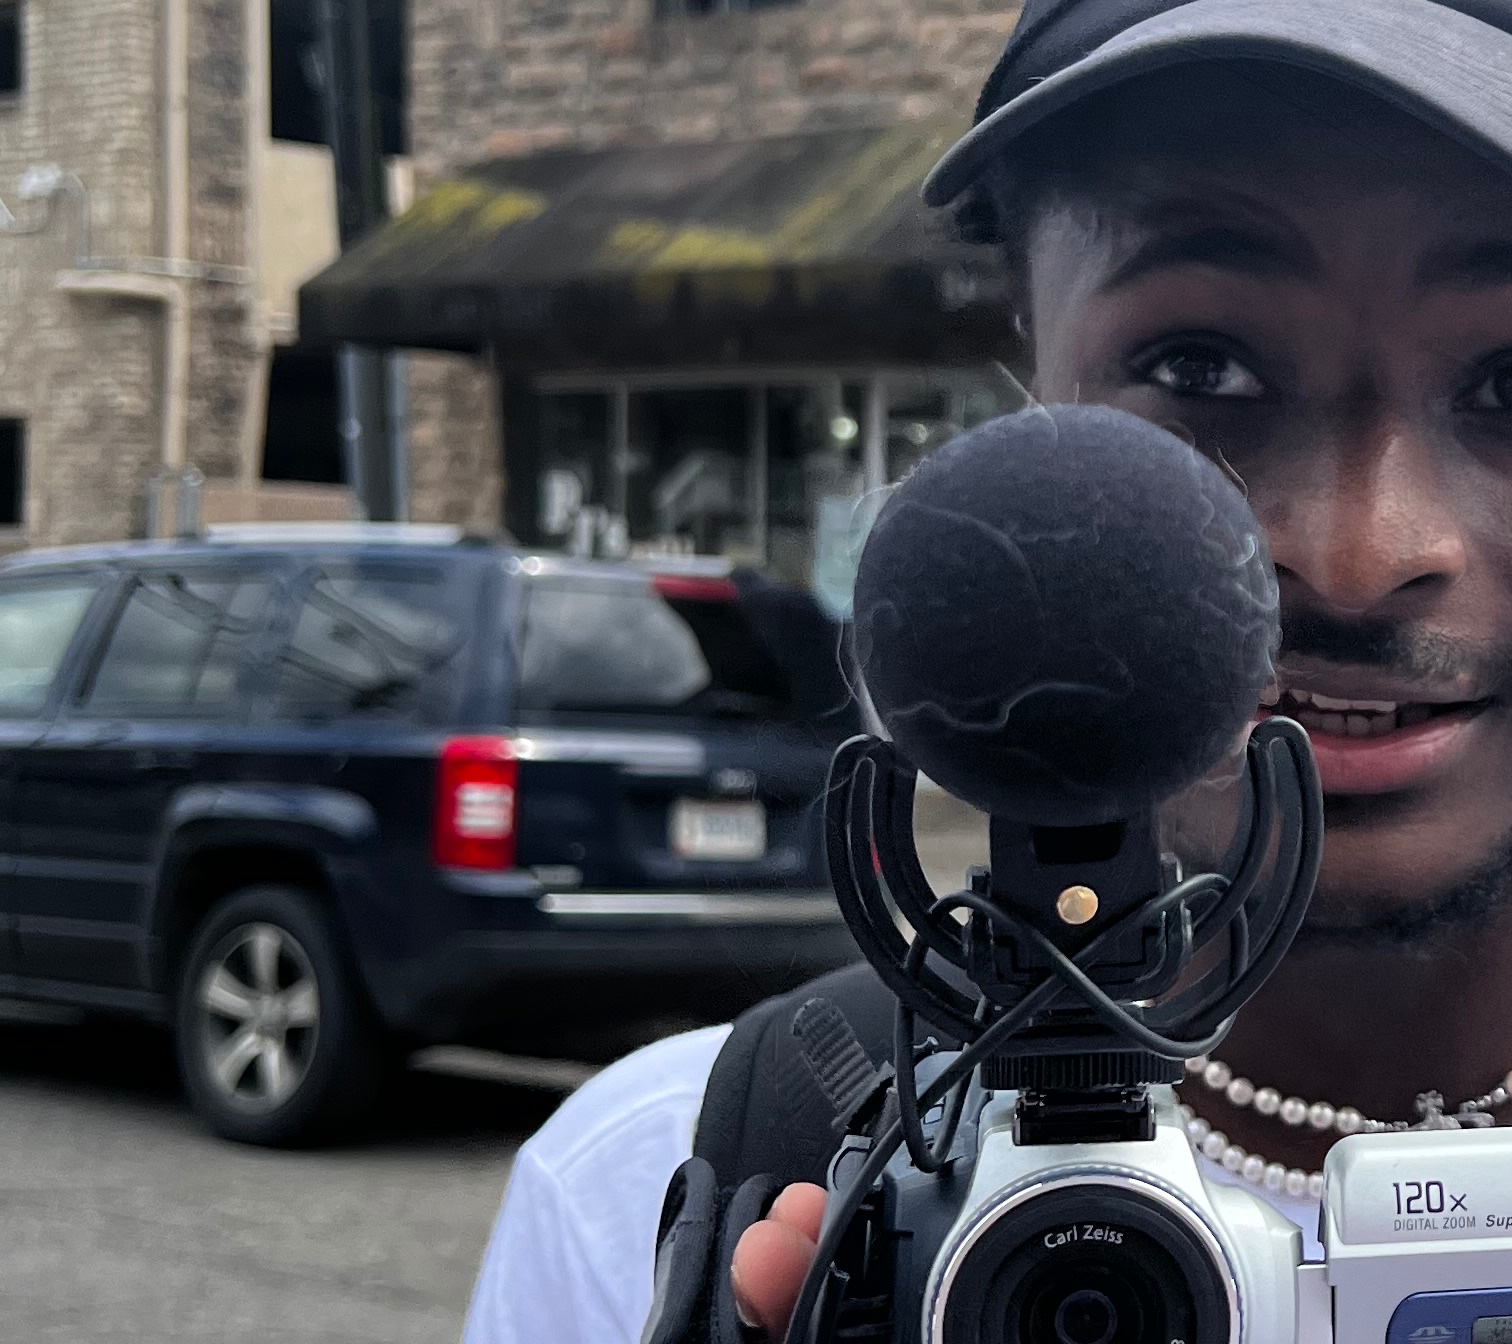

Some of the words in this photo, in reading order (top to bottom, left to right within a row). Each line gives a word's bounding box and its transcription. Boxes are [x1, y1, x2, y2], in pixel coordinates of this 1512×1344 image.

[1393, 1217, 1439, 1231] DIGITAL
[1442, 1216, 1476, 1230] ZOOM
[1044, 1225, 1078, 1248] Carl
[1082, 1224, 1124, 1244] Zeiss
